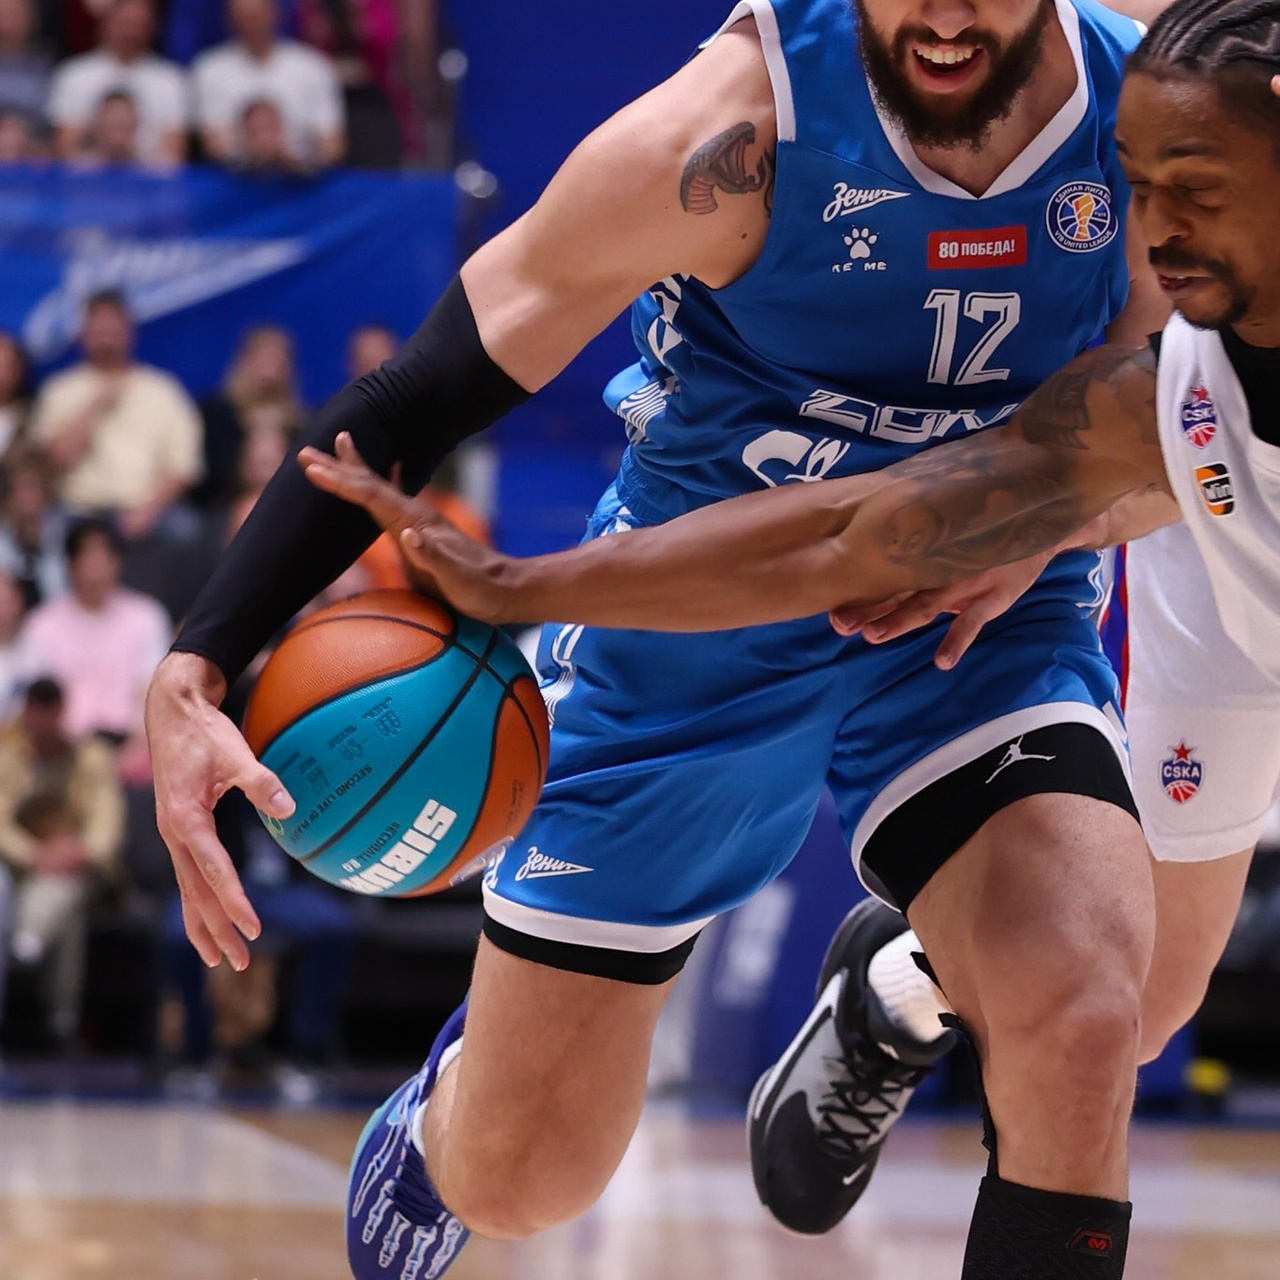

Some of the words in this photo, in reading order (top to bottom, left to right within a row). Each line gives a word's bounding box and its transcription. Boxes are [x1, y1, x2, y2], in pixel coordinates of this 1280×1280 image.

[1055, 185, 1083, 203] ЕДИНАЯ
[1084, 186, 1104, 196] ЛИГА
[938, 240, 959, 258] 80
[961, 239, 1015, 257] ПОБЕДА!
[1055, 230, 1063, 242] VTB
[1064, 240, 1088, 248] UNITED
[1090, 231, 1112, 247] LEAGUE
[923, 289, 1021, 385] 12
[334, 764, 373, 797] SECOND
[1163, 765, 1200, 778] CSKA
[316, 793, 337, 813] LIFE
